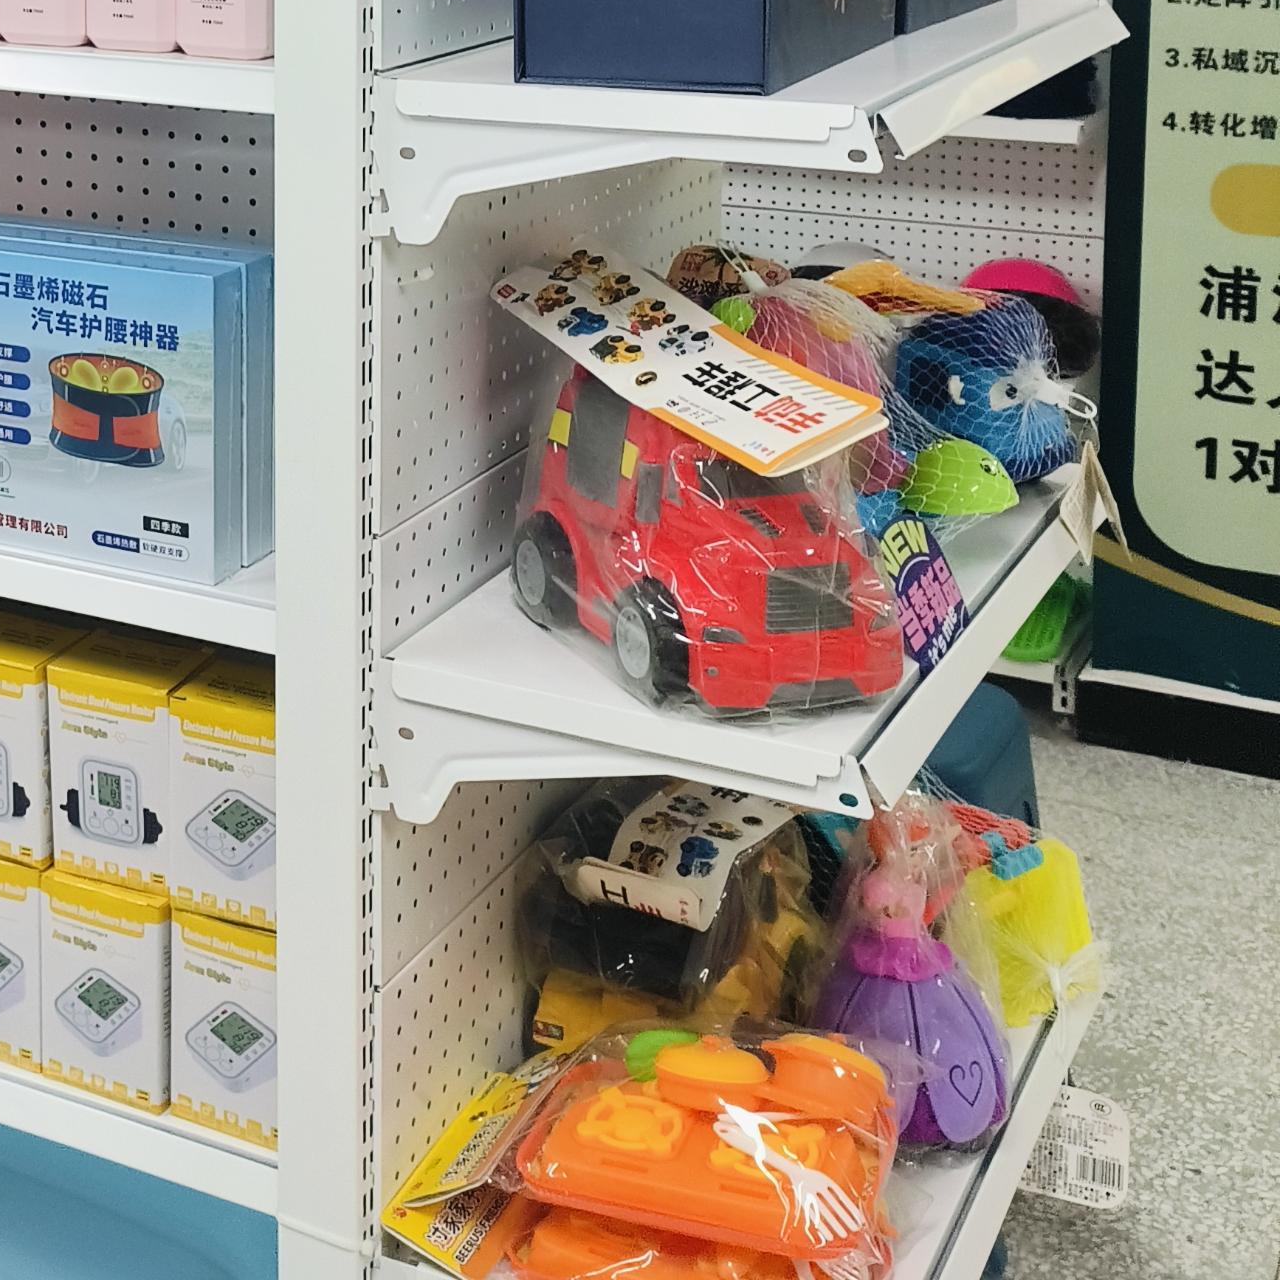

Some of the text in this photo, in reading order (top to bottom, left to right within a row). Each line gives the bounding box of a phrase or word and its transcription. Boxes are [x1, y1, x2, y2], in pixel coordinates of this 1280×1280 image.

[1199, 264, 1280, 326] 浦
[31, 306, 180, 353] 汽车护腰神器
[683, 361, 828, 435] 手动工程车
[1194, 348, 1280, 410] 达
[879, 519, 929, 578] NEW
[455, 1227, 484, 1264] BEERUS
